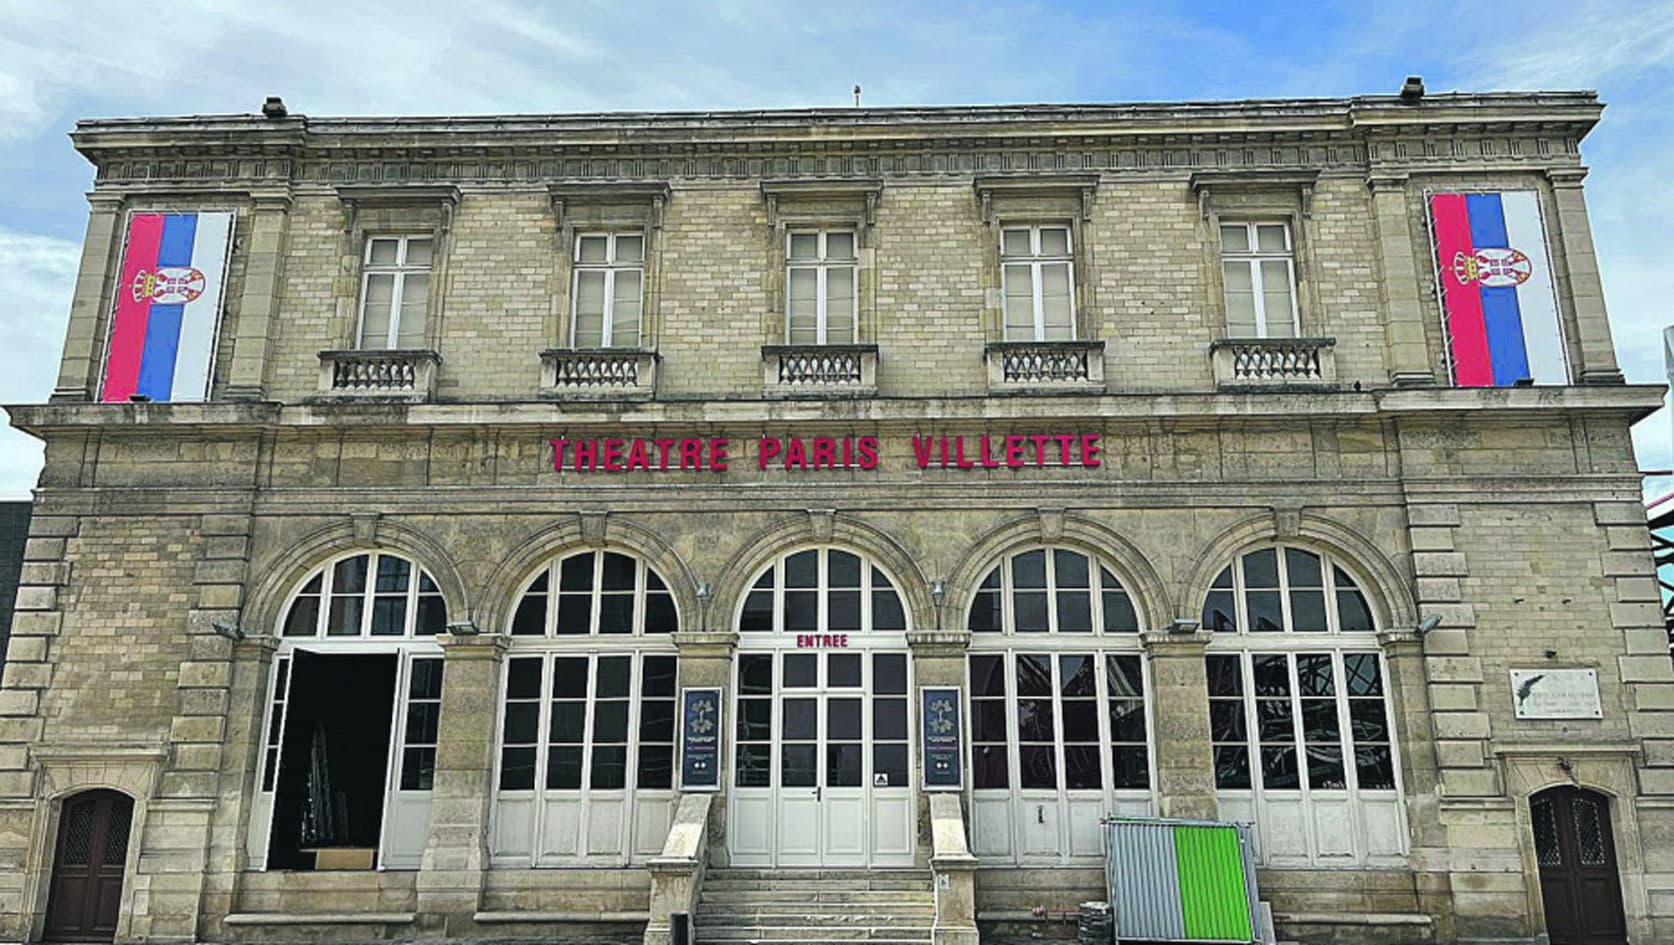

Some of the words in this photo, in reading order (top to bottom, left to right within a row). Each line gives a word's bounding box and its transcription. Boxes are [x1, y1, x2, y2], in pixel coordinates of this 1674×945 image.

[550, 438, 729, 472] THEATRE
[759, 436, 879, 471] PARIS
[913, 434, 1102, 469] VILLETTE
[797, 634, 848, 648] ENTREE
